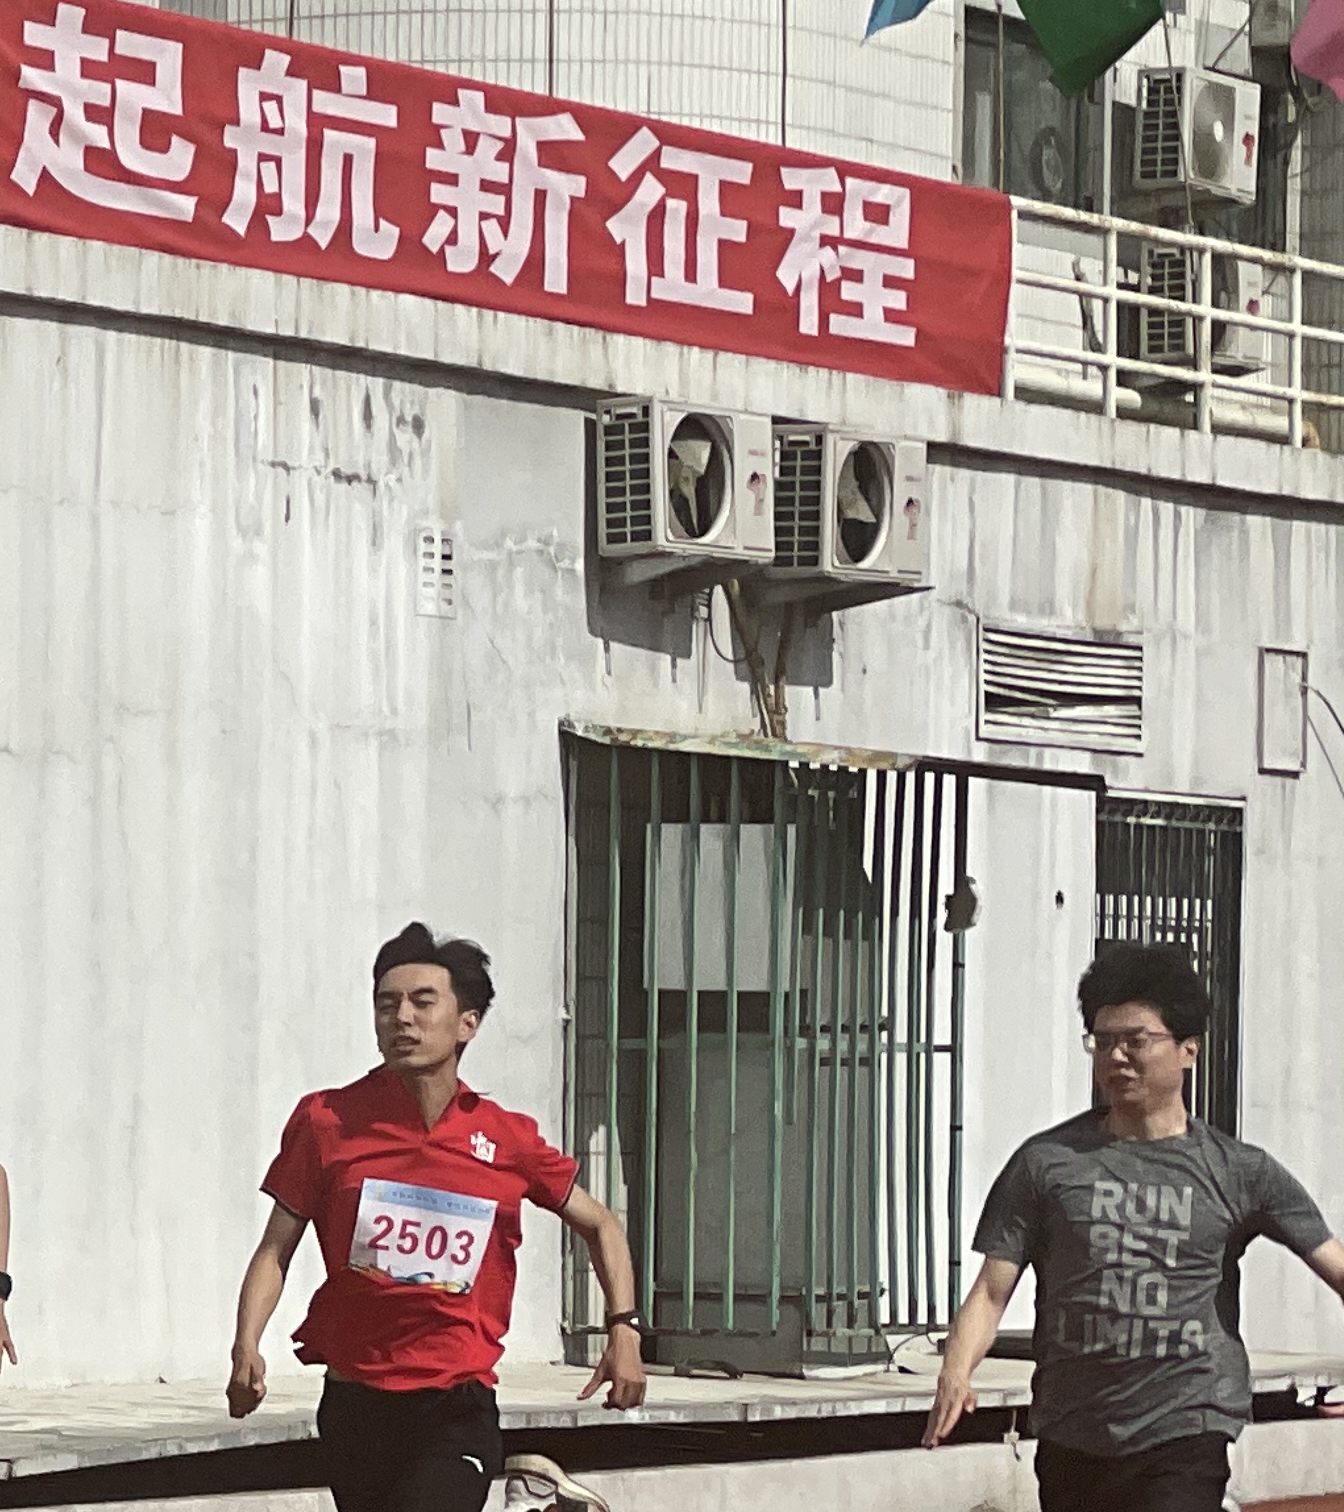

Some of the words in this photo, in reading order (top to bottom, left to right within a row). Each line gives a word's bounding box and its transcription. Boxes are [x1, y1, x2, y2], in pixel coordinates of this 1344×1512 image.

[10, 2, 917, 348] 起航新征程
[1091, 1180, 1193, 1230] RUN
[368, 1215, 475, 1266] 2503
[1089, 1223, 1191, 1269] SET
[1099, 1269, 1169, 1316] NO
